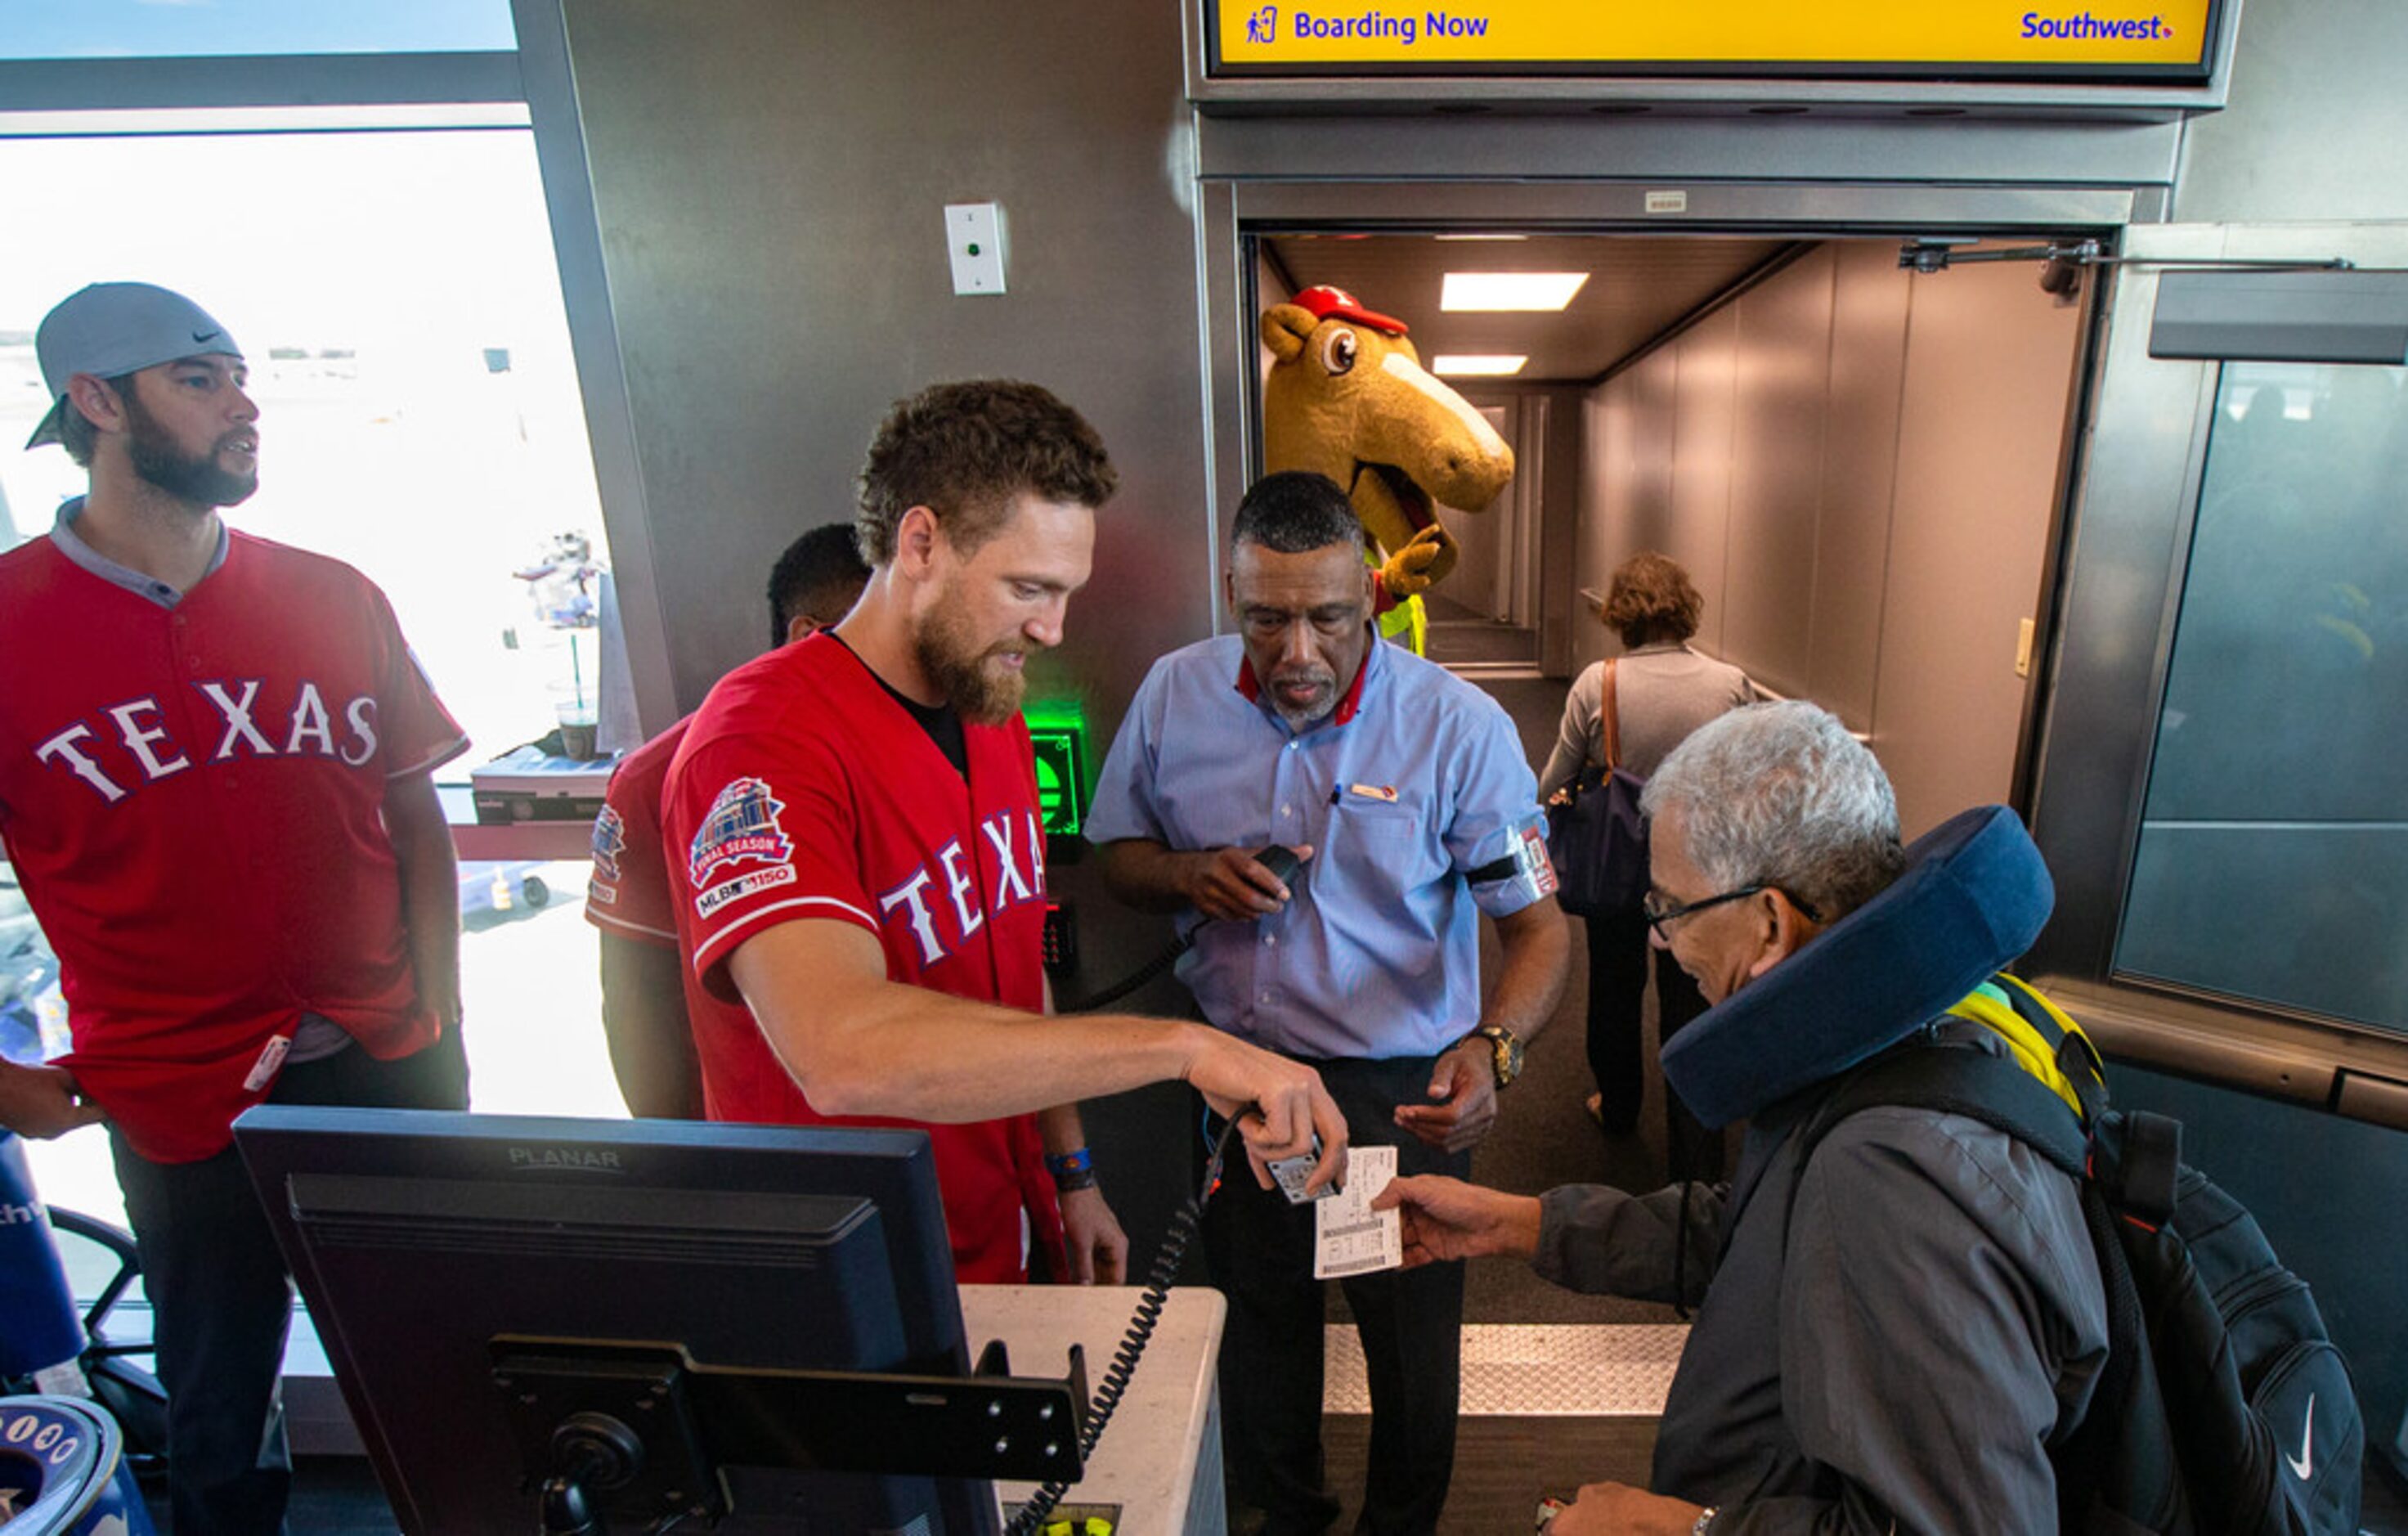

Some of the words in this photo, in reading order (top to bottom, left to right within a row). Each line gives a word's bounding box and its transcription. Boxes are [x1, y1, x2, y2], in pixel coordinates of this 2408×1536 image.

[1294, 11, 1416, 45] Boarding
[1426, 11, 1489, 37] Now
[2020, 11, 2162, 39] Southwest
[33, 679, 378, 804] TEXAS
[725, 837, 775, 854] SEASON
[700, 886, 730, 914] MLB
[508, 1147, 621, 1168] PLANAR
